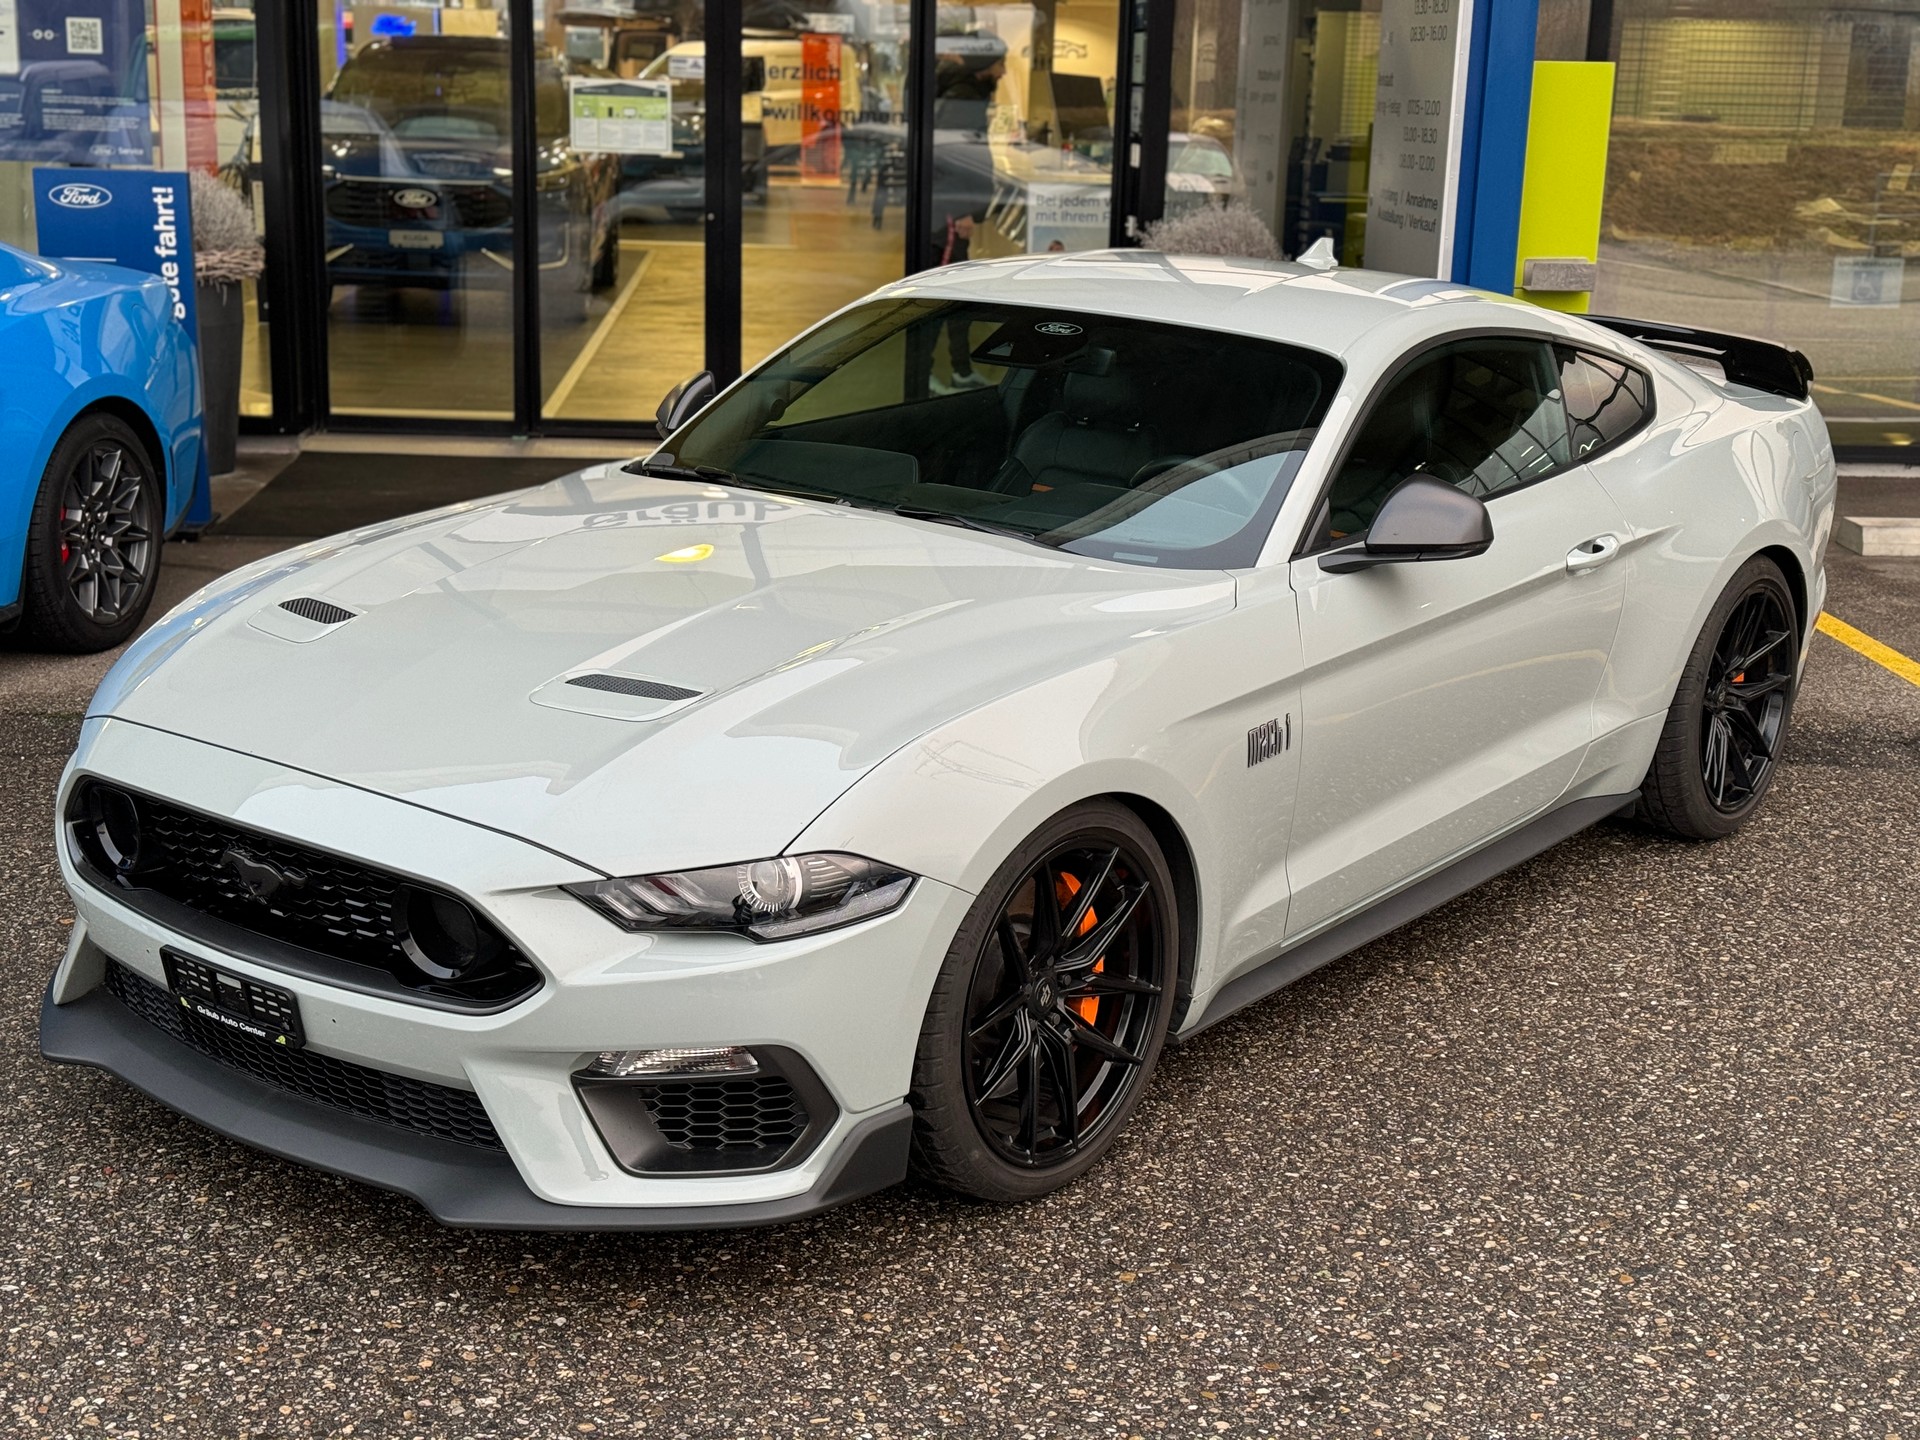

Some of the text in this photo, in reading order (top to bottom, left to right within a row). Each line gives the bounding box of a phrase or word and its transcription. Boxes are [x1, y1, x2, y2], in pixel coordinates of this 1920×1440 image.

[766, 62, 842, 81] erzlich
[60, 186, 102, 205] Ford
[1058, 195, 1100, 208] jedem
[1405, 191, 1438, 211] Annahme
[151, 186, 178, 258] fahrt!
[1035, 211, 1057, 222] mit
[1409, 214, 1437, 233] Verkauf
[1041, 322, 1076, 334] Ford
[220, 1014, 239, 1028] Auto
[239, 1022, 267, 1038] Center
